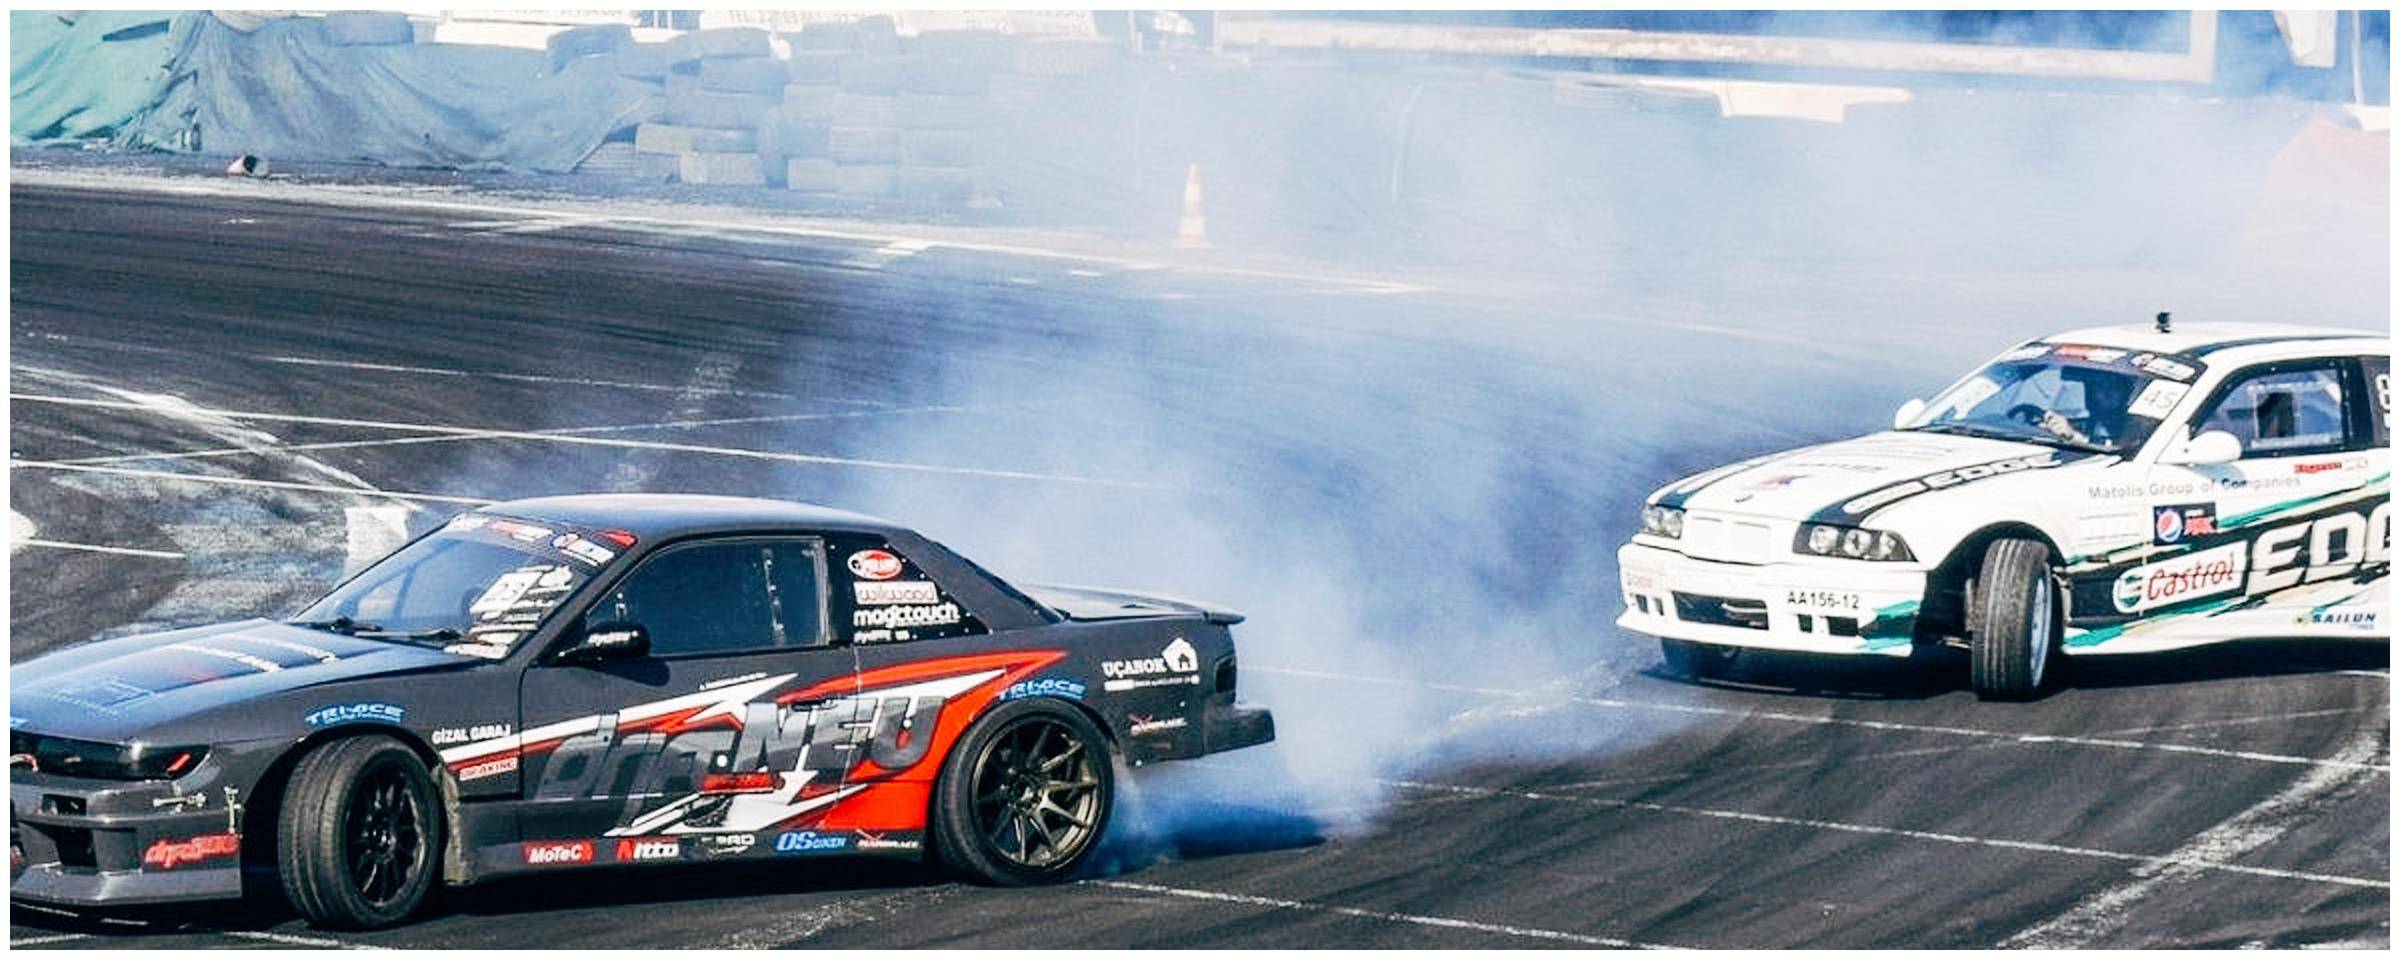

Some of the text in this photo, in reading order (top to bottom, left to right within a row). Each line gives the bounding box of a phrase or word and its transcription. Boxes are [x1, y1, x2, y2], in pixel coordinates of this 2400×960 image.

[2143, 389, 2178, 409] 45
[2088, 477, 2301, 499] Matolis Group of Companies
[2148, 552, 2236, 600] Castrol
[1788, 591, 1860, 609] AA156-12
[2311, 612, 2376, 624] SAILUN
[529, 844, 582, 864] MoTeC
